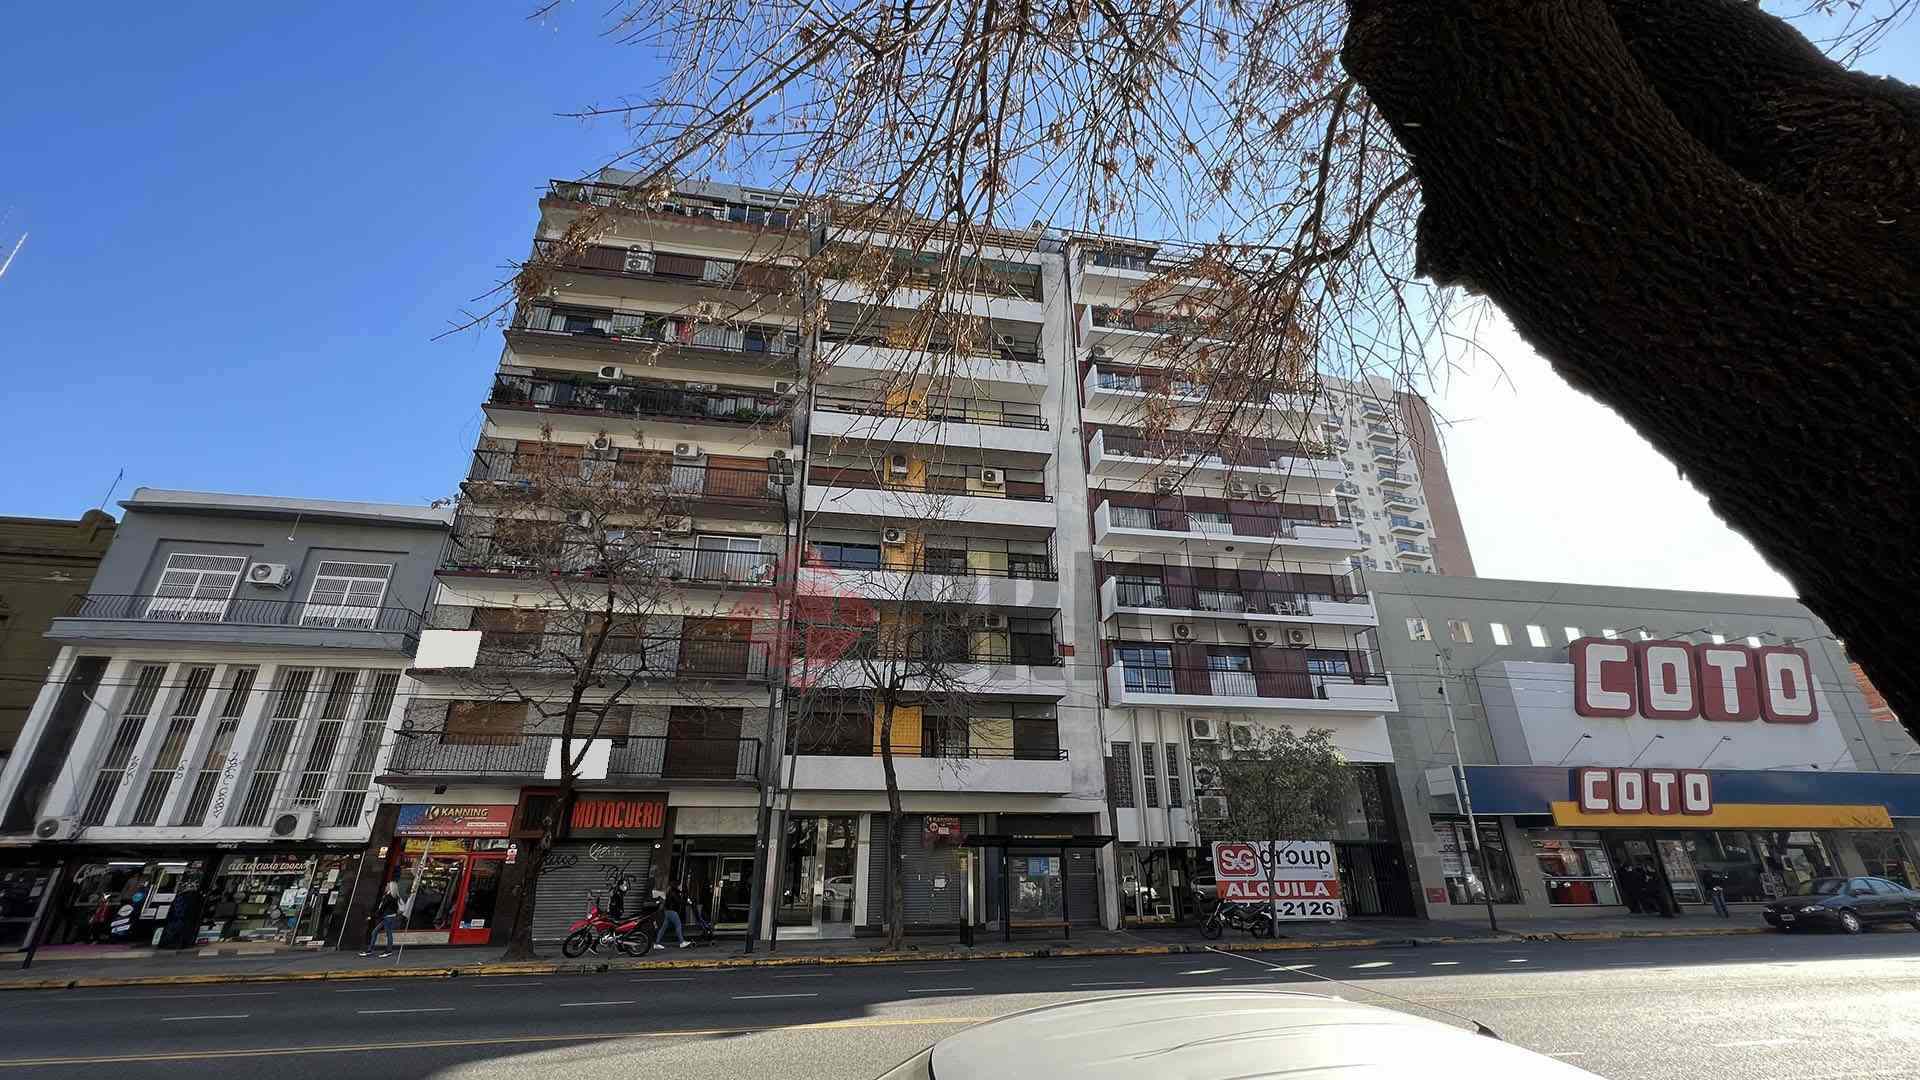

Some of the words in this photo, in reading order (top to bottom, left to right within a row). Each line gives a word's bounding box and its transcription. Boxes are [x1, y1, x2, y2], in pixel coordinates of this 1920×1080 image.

[1585, 642, 1814, 717] COTO
[1584, 770, 1711, 812] COTO
[441, 806, 490, 818] KANNING
[571, 800, 665, 829] MOTOCUERO
[1260, 849, 1332, 870] group
